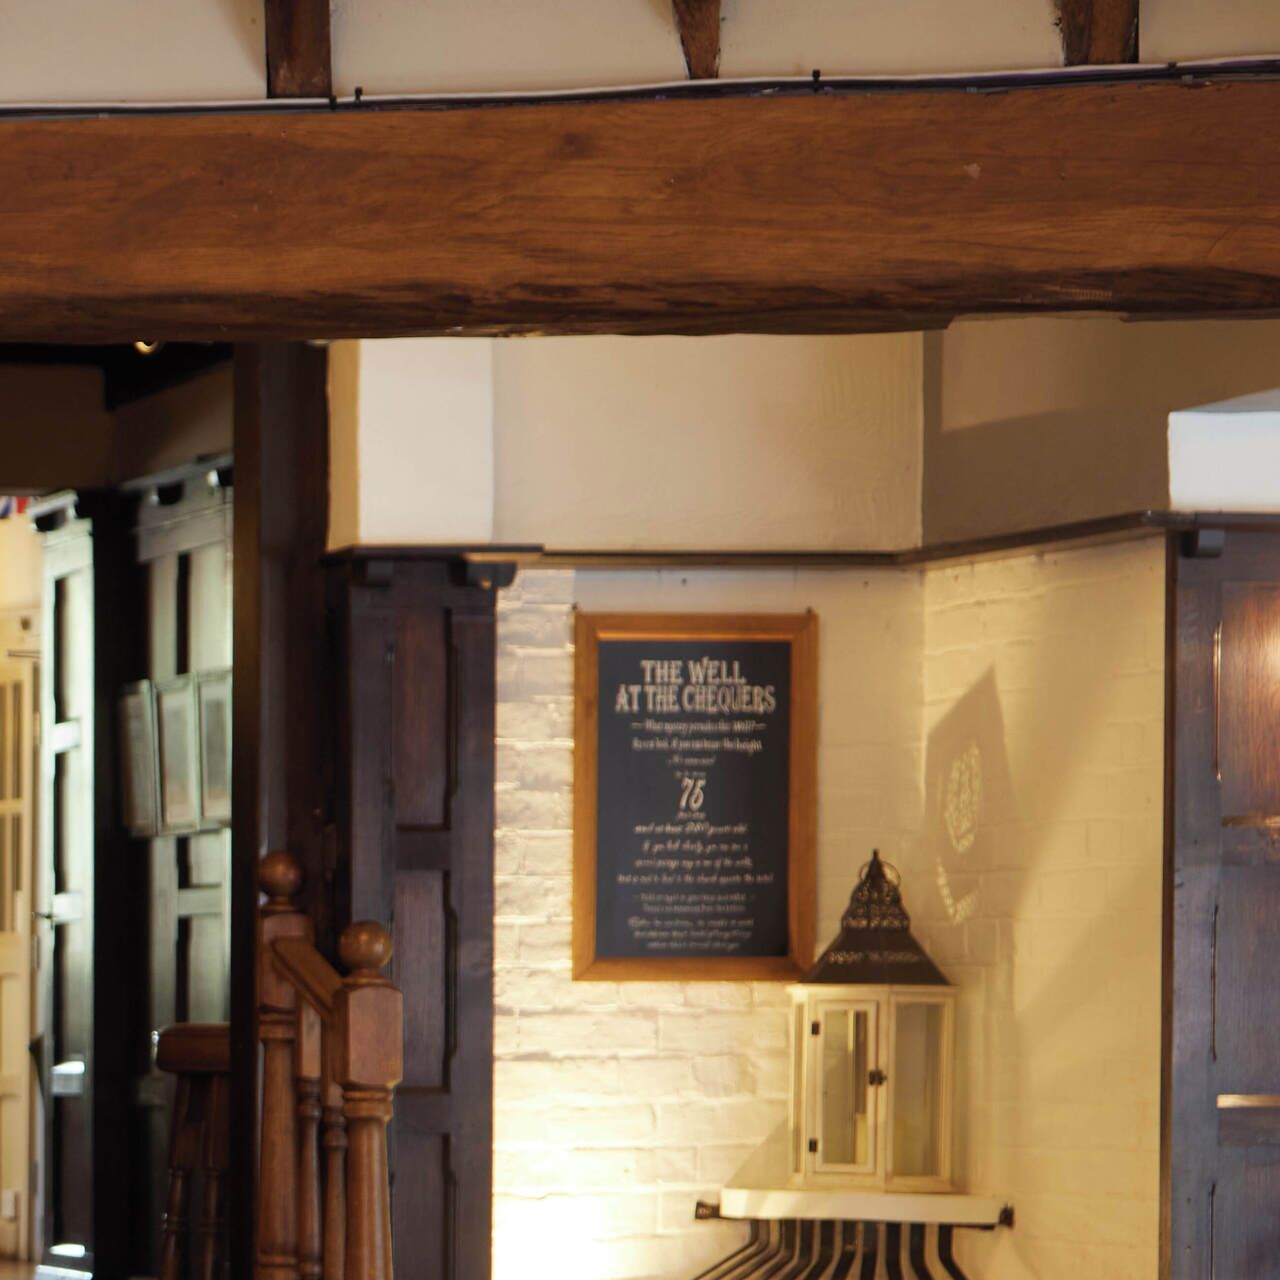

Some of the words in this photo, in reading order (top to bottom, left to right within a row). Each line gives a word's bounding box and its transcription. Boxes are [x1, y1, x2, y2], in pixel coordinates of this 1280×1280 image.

[640, 659, 683, 684] THE
[687, 655, 747, 685] WELL
[614, 683, 642, 713] AT
[643, 684, 682, 713] THE
[682, 684, 777, 715] CHEQUERS
[679, 776, 707, 812] 75
